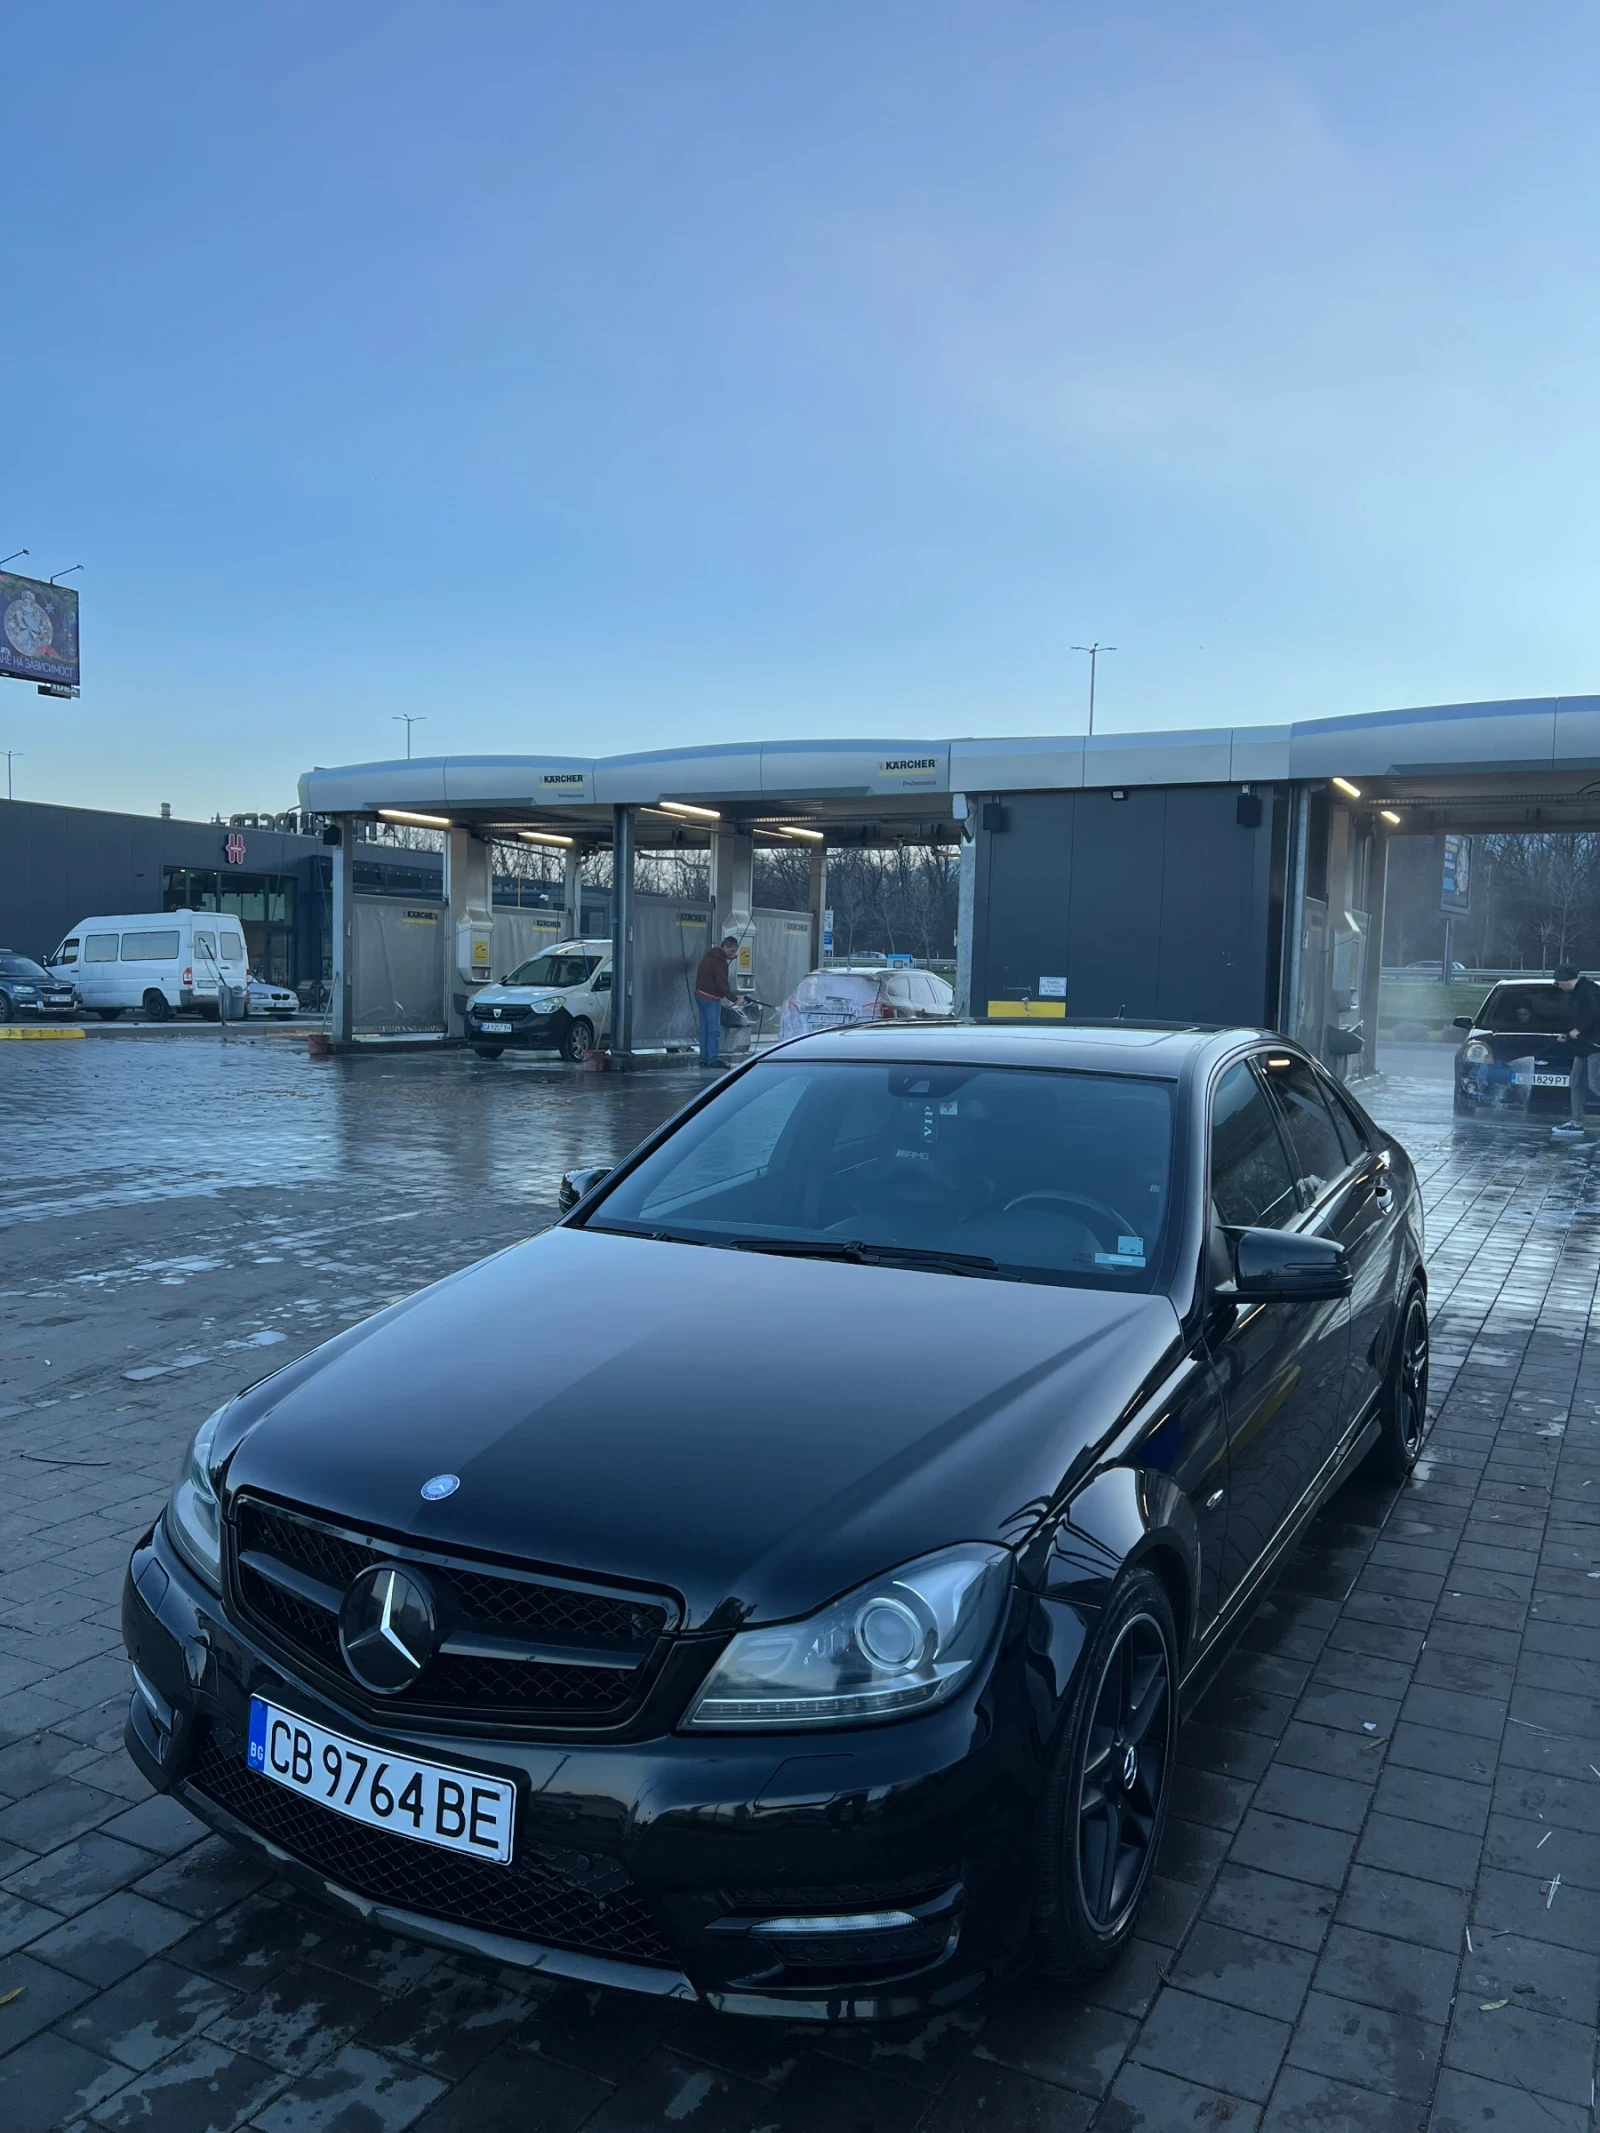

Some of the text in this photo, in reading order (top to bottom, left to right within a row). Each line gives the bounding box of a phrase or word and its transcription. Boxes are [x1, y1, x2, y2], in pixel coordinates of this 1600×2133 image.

[13, 656, 24, 668] НА
[25, 659, 73, 677] ЗАВИСИМОСТ
[886, 759, 936, 770] KÄRCHER
[544, 774, 583, 784] KÄRCHER
[1533, 1075, 1554, 1085] 1829
[1555, 1077, 1568, 1085] PT
[250, 1741, 264, 1760] BG
[270, 1719, 501, 1849] CB 9764 BE
